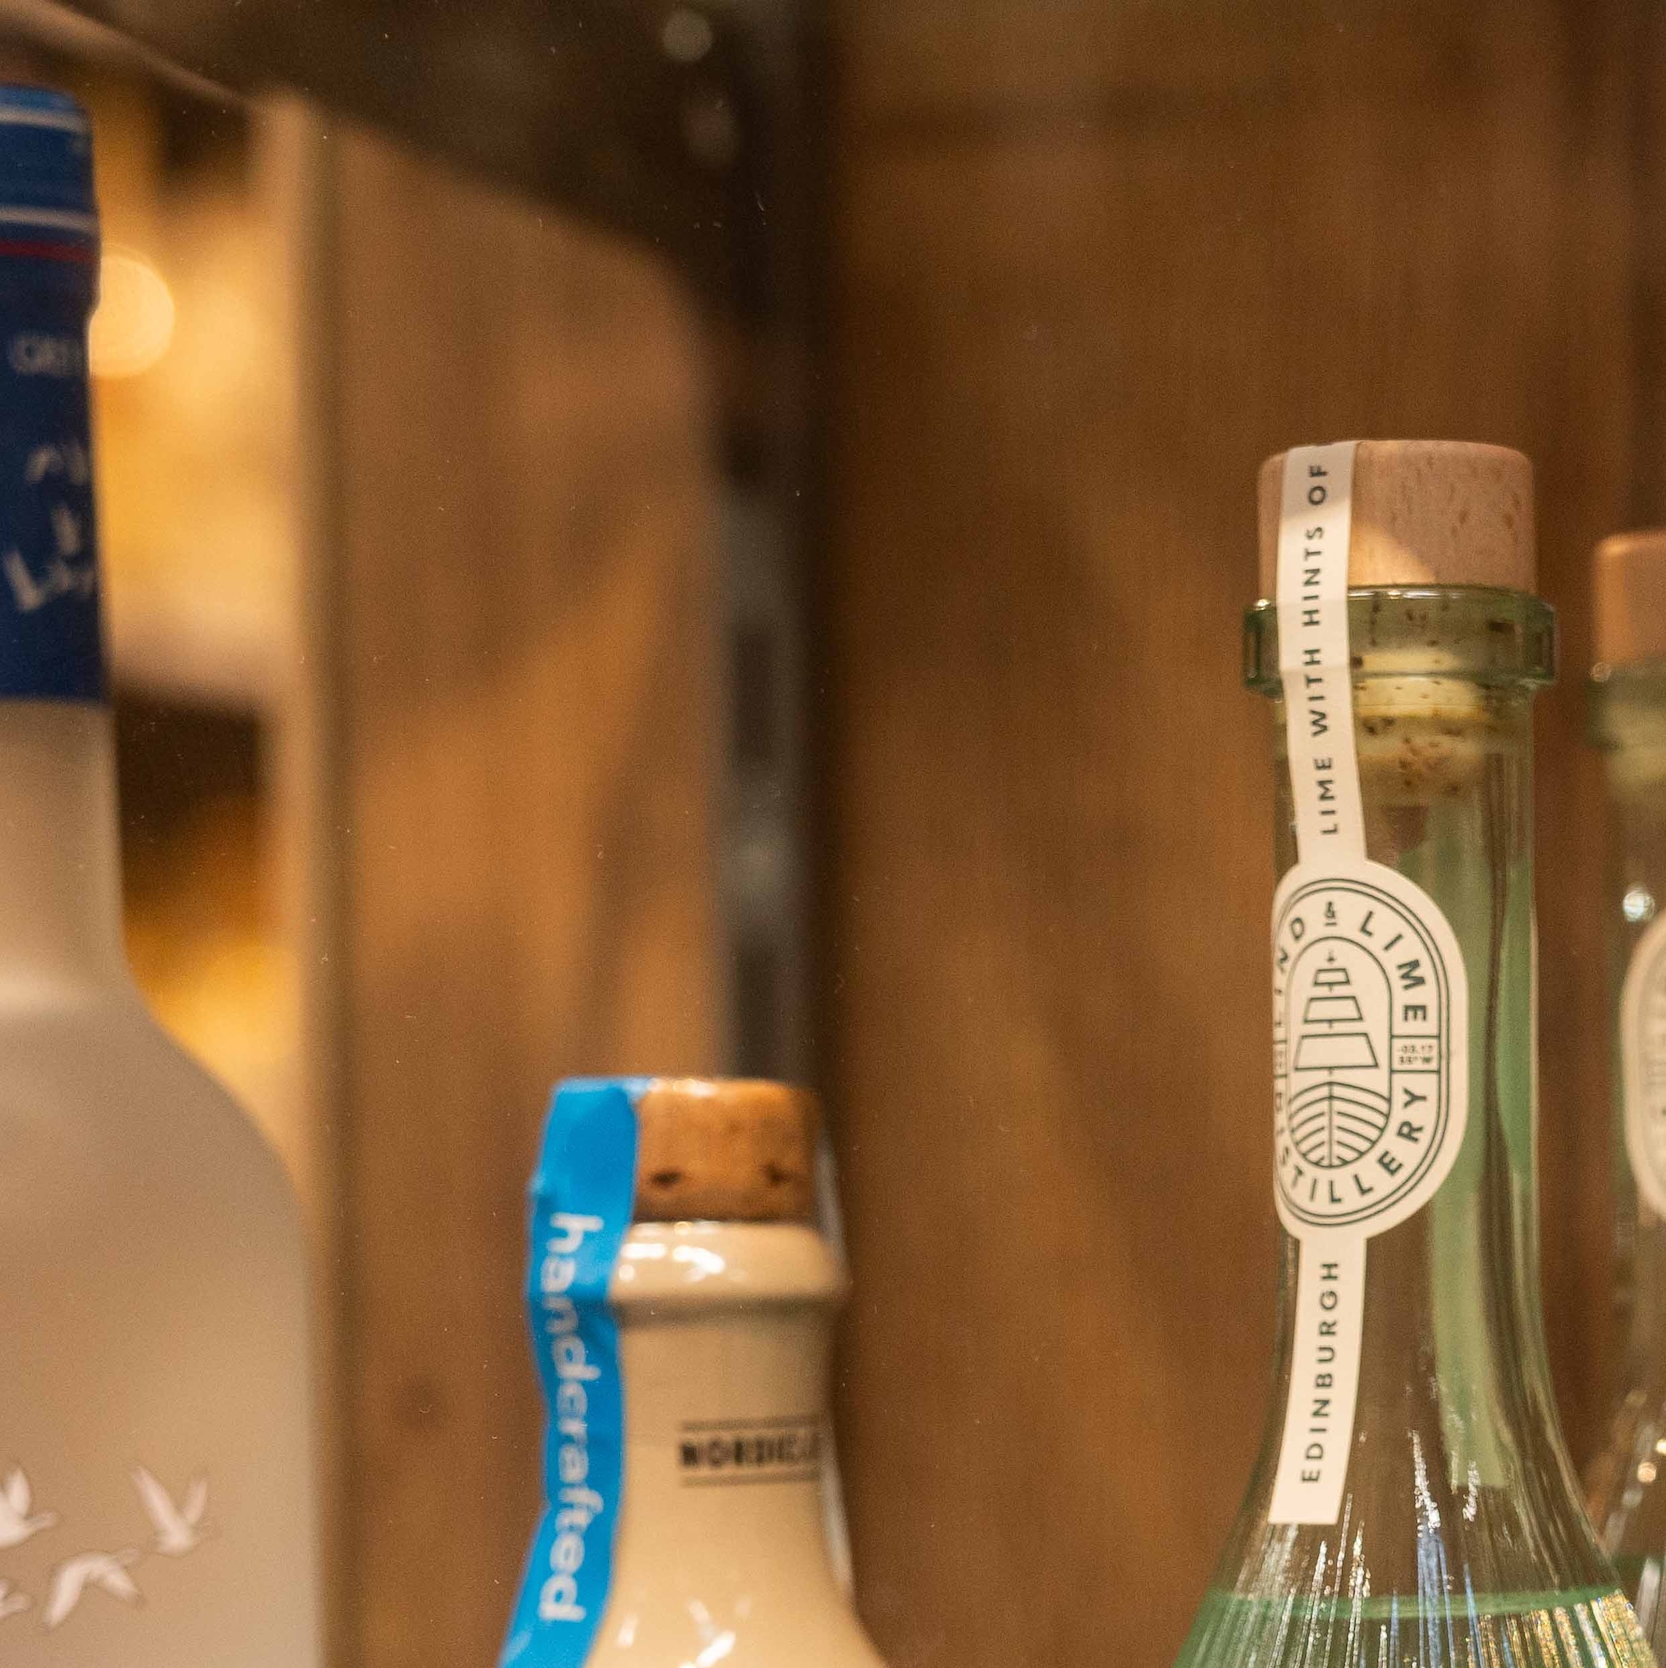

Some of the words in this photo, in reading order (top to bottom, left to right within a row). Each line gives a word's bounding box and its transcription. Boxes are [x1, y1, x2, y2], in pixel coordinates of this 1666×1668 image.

[1307, 465, 1328, 506] OF
[1302, 526, 1325, 627] HINTS
[1303, 647, 1334, 737] WITH
[1314, 756, 1339, 836] LIME
[1358, 910, 1427, 1022] LIME
[537, 1212, 604, 1622] handcrafted
[1302, 1262, 1340, 1483] EDINBURGH
